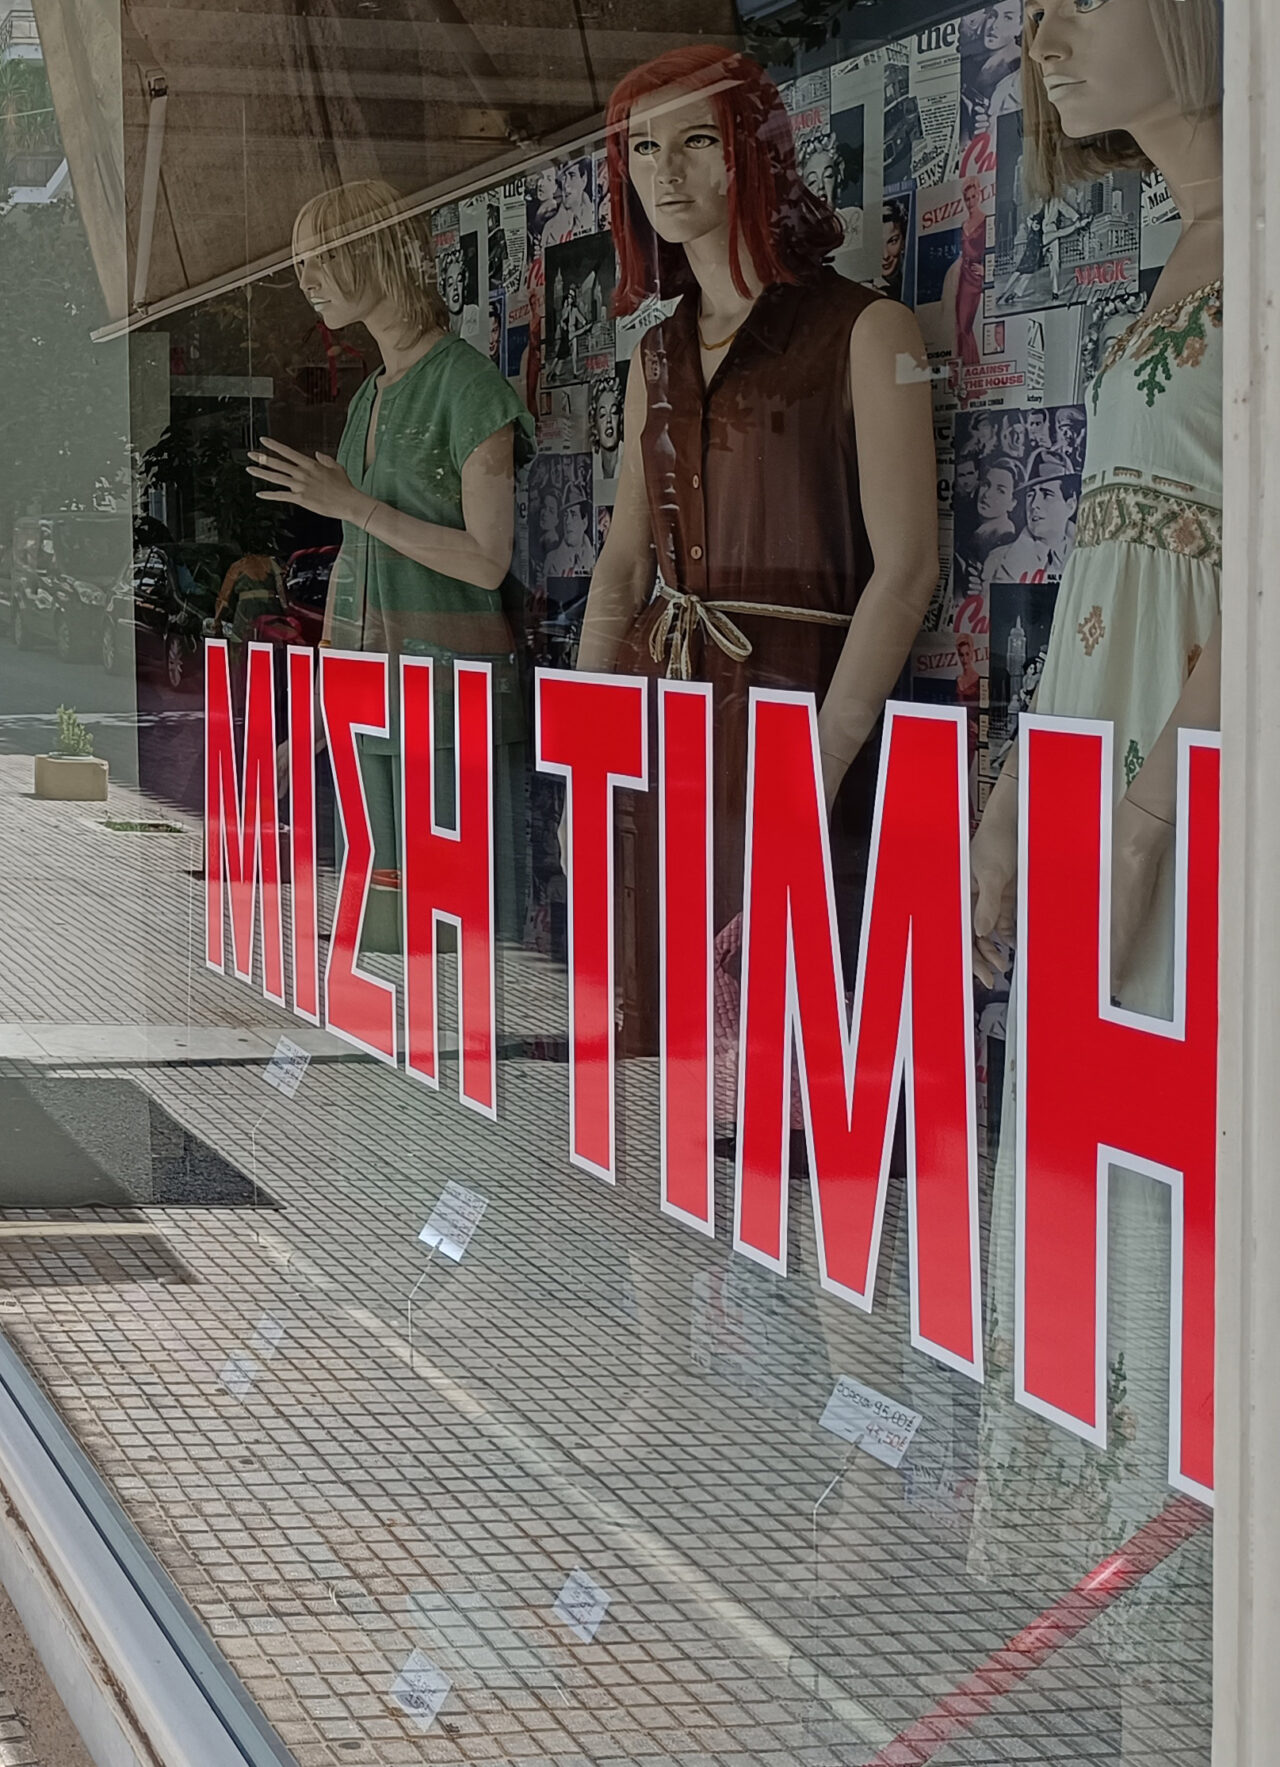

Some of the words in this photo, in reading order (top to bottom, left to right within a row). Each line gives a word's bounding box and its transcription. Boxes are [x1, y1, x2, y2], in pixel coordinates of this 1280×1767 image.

[1074, 258, 1132, 286] MAGIC
[964, 364, 1011, 377] AGAINST
[963, 379, 984, 390] THE
[985, 374, 1024, 387] HOUSE
[204, 638, 498, 1121] ΜΙΣΗ
[536, 667, 1221, 1506] ΤΙΜΗ
